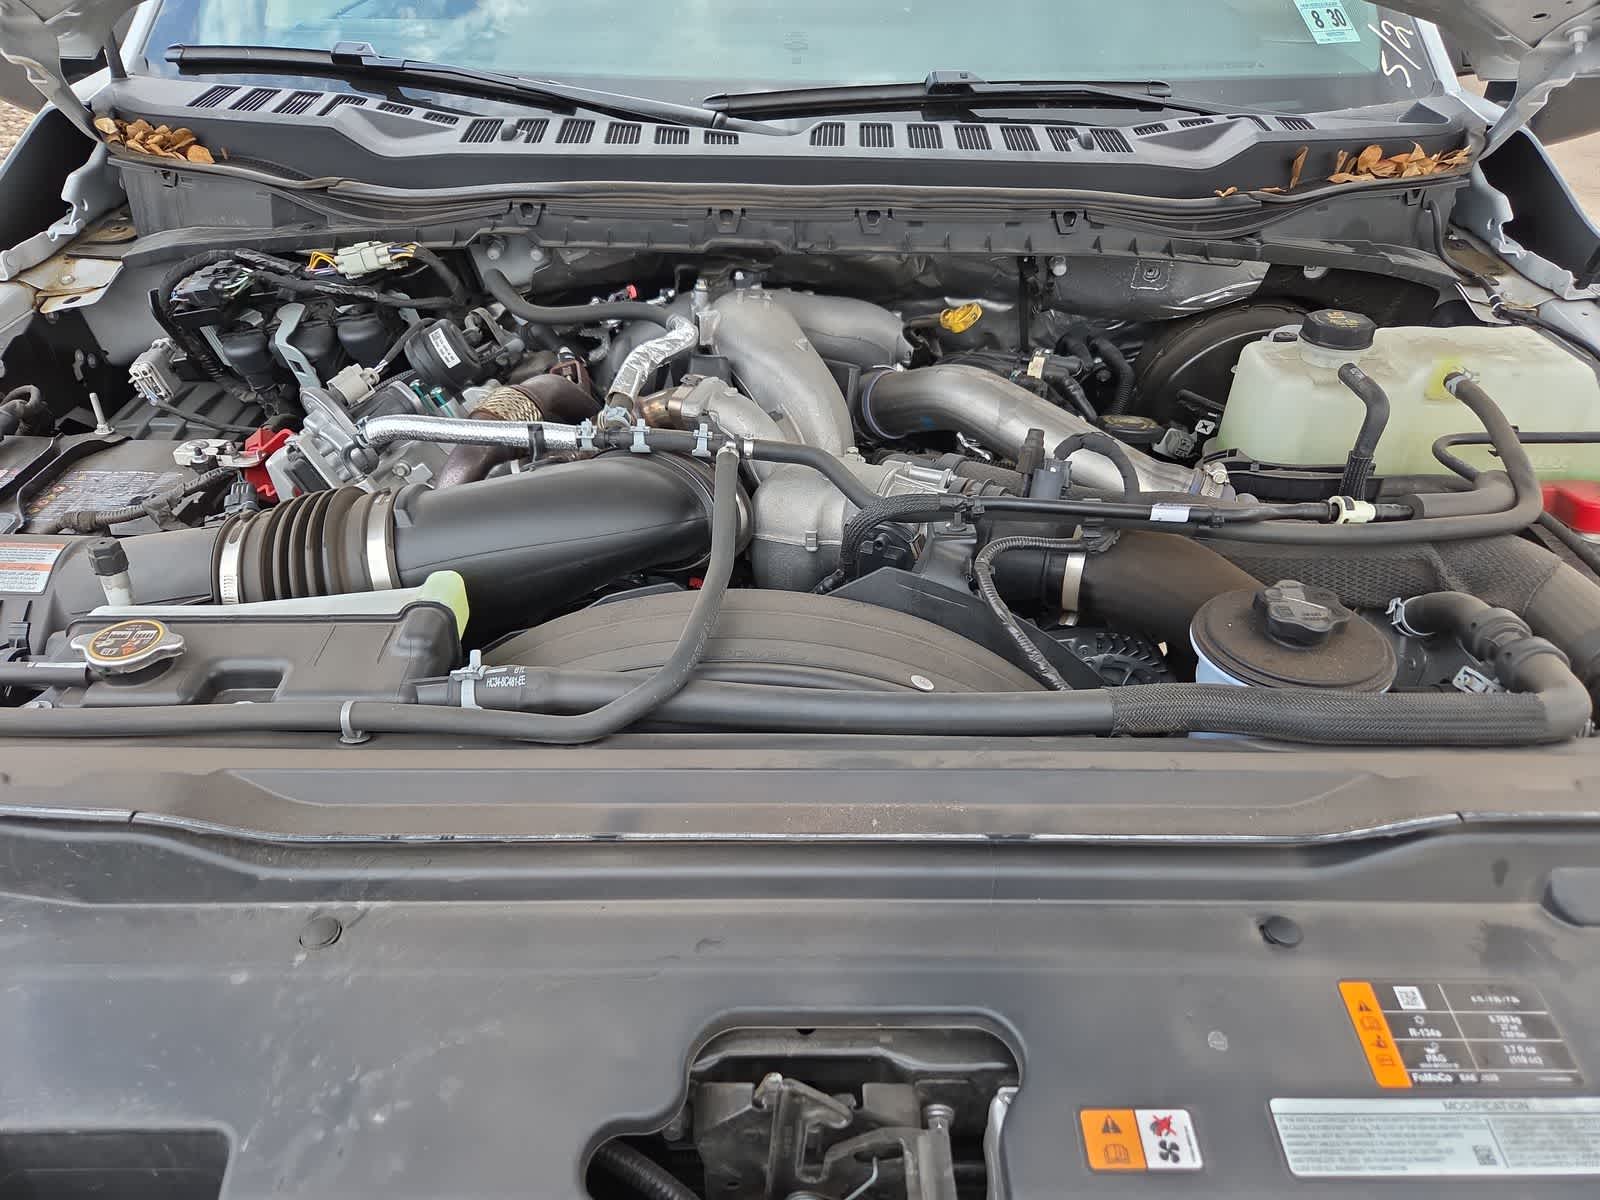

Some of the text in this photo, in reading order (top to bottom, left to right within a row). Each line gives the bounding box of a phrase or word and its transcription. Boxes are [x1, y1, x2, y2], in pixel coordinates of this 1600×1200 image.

[1310, 9, 1347, 28] 8 30
[1408, 1028, 1442, 1038] R-134a
[1411, 1072, 1453, 1083] FoMoCo
